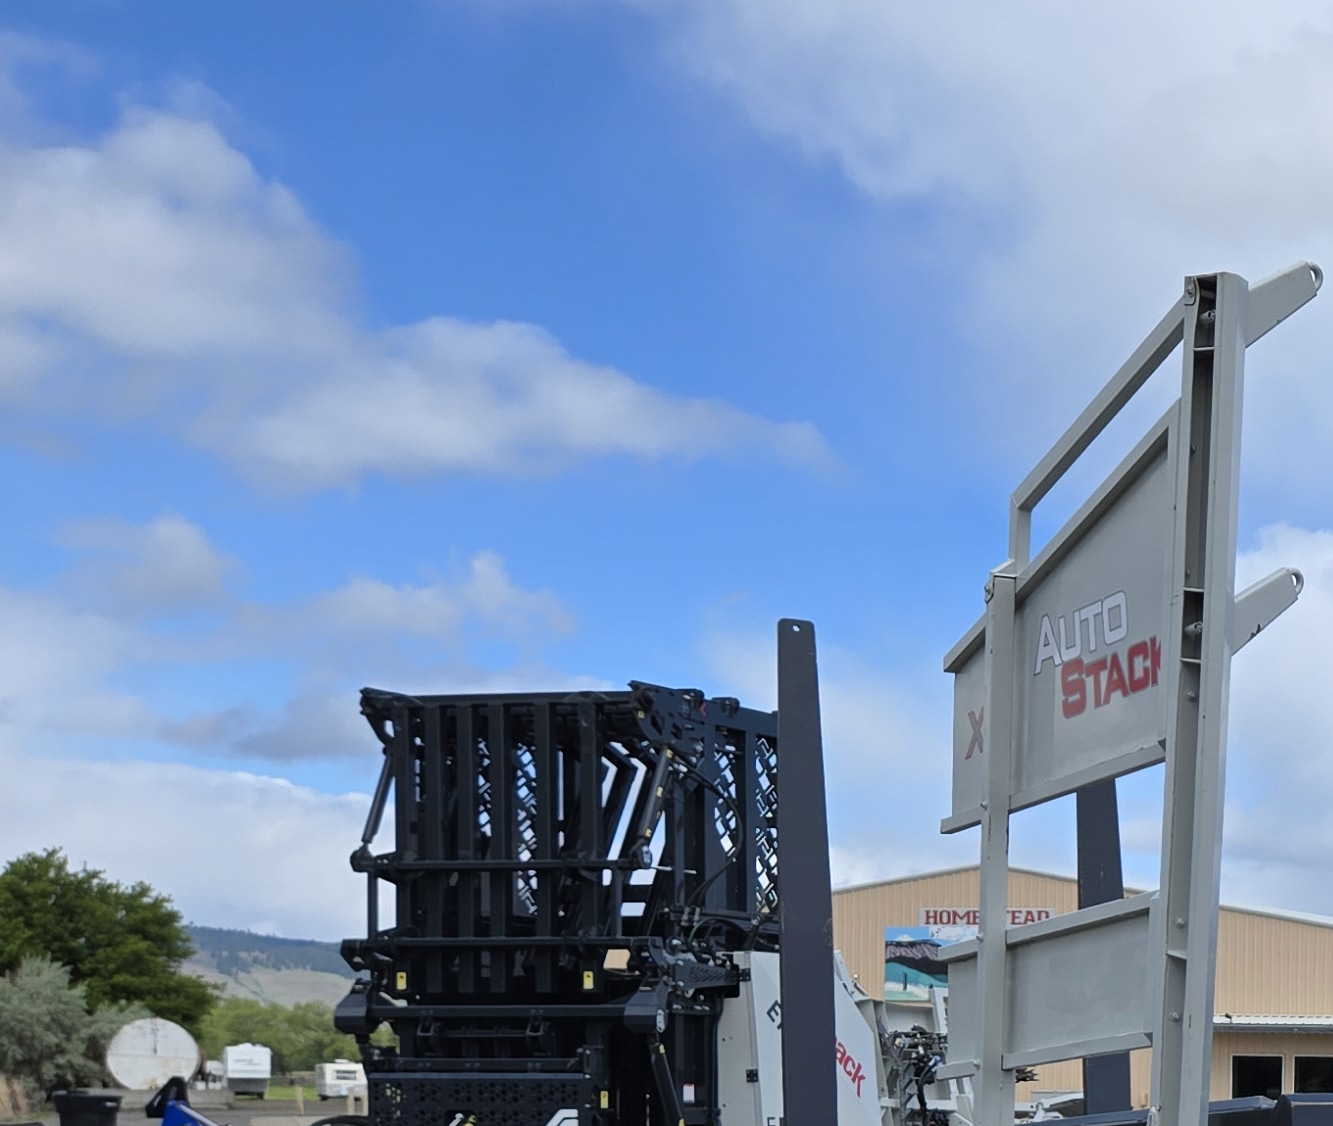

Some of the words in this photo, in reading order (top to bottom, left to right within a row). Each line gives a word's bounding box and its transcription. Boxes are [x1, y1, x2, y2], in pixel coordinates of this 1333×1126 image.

[1033, 590, 1127, 676] AUTO
[925, 910, 1050, 925] HOMEEAD
[835, 1034, 866, 1098] ack
